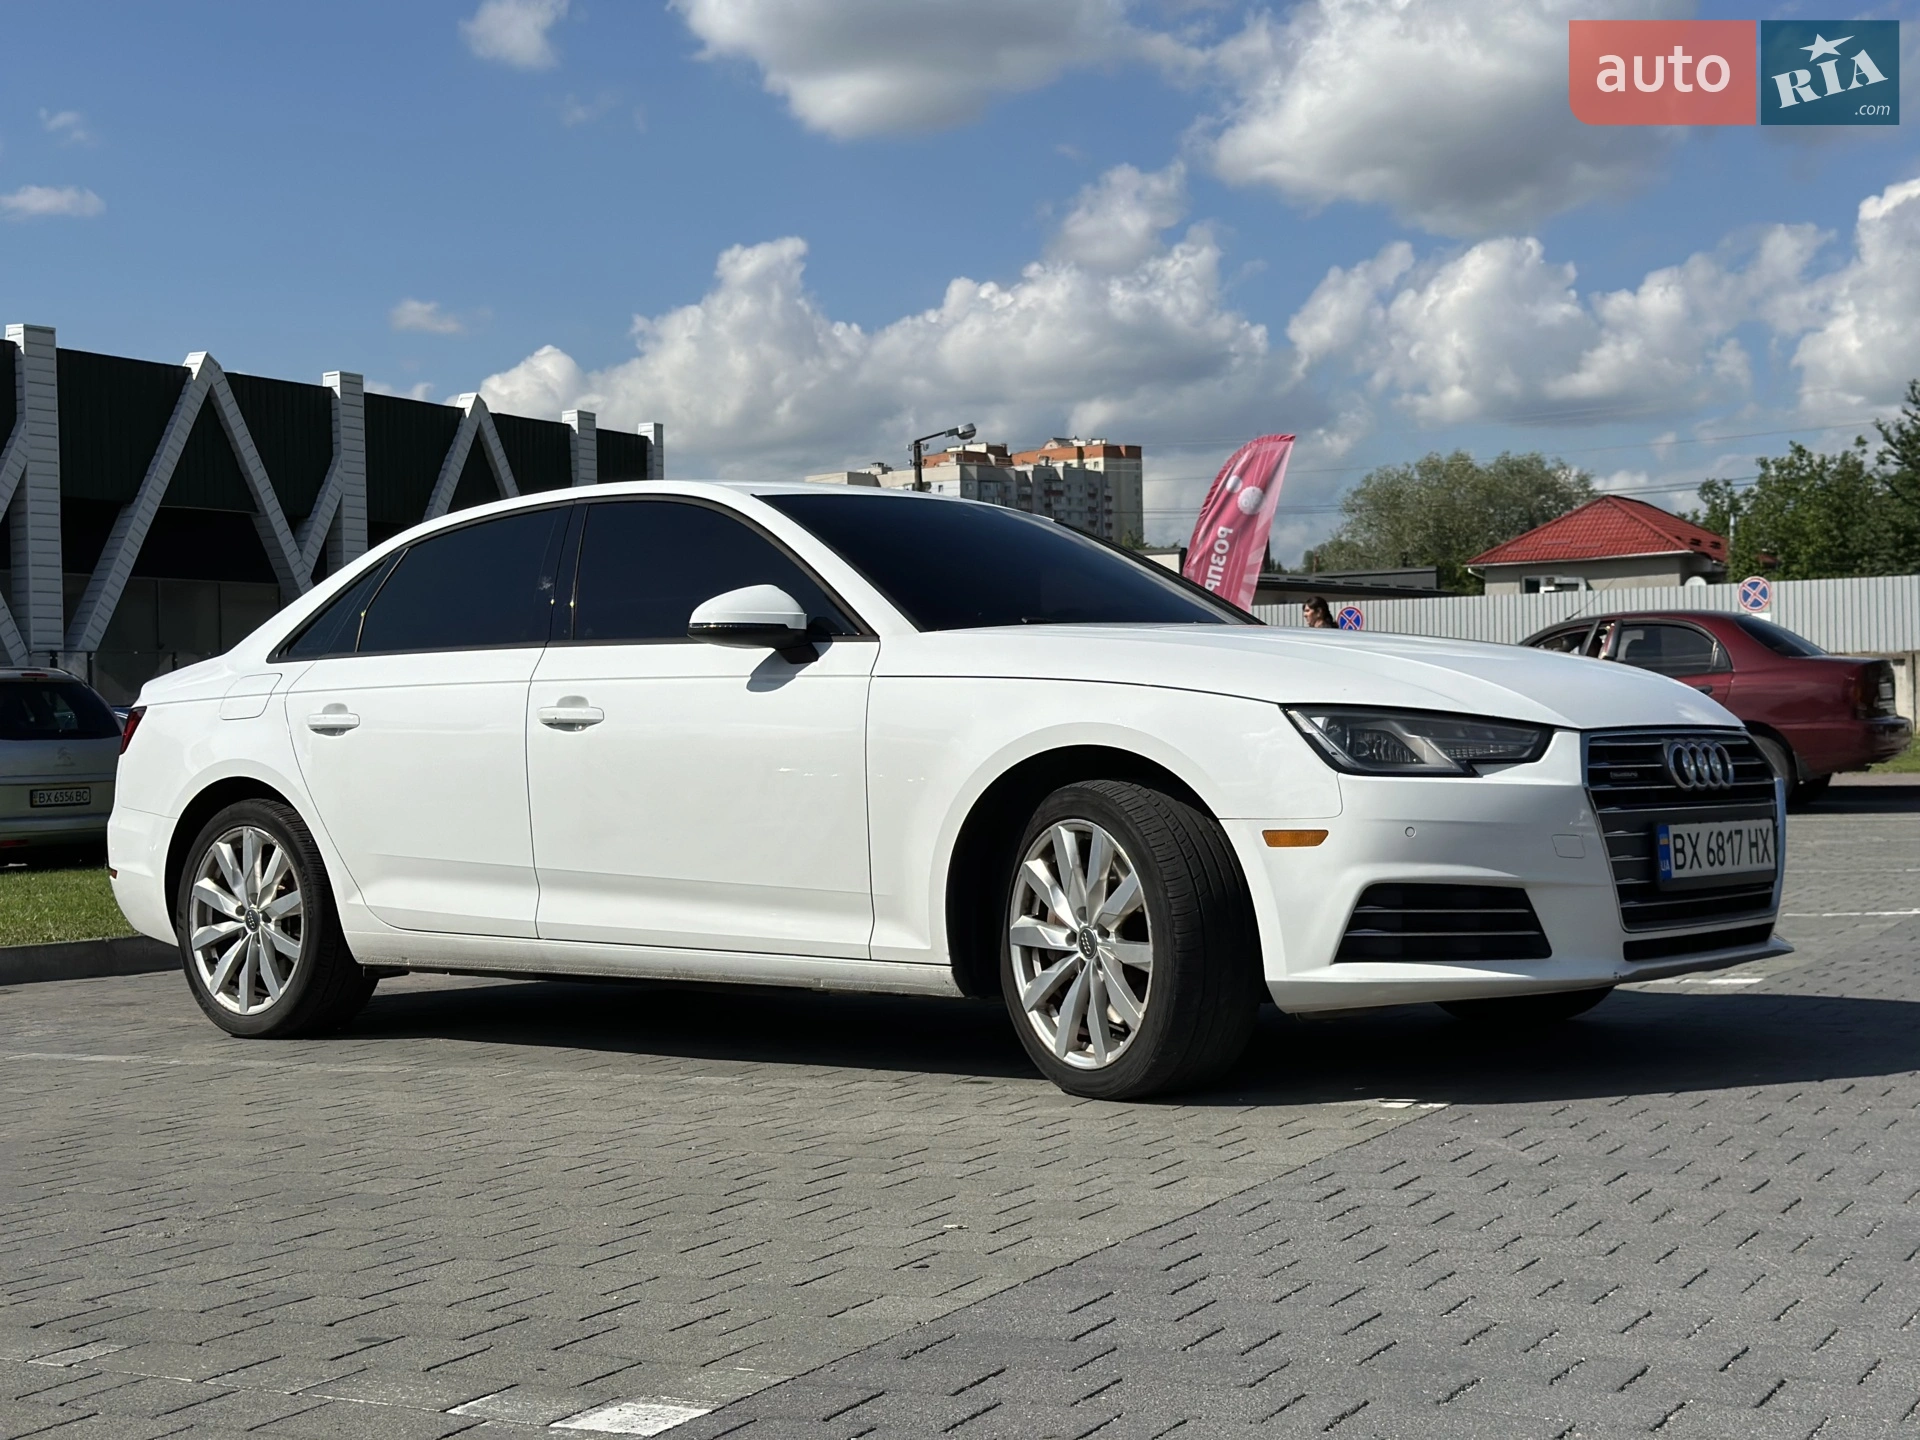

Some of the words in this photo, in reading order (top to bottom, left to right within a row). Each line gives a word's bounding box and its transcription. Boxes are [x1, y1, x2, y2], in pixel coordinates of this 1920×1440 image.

[54, 791, 74, 802] 6556
[1673, 831, 1702, 870] BX
[1706, 828, 1743, 867] 6817
[1748, 827, 1772, 864] HX
[1660, 860, 1670, 871] UA
